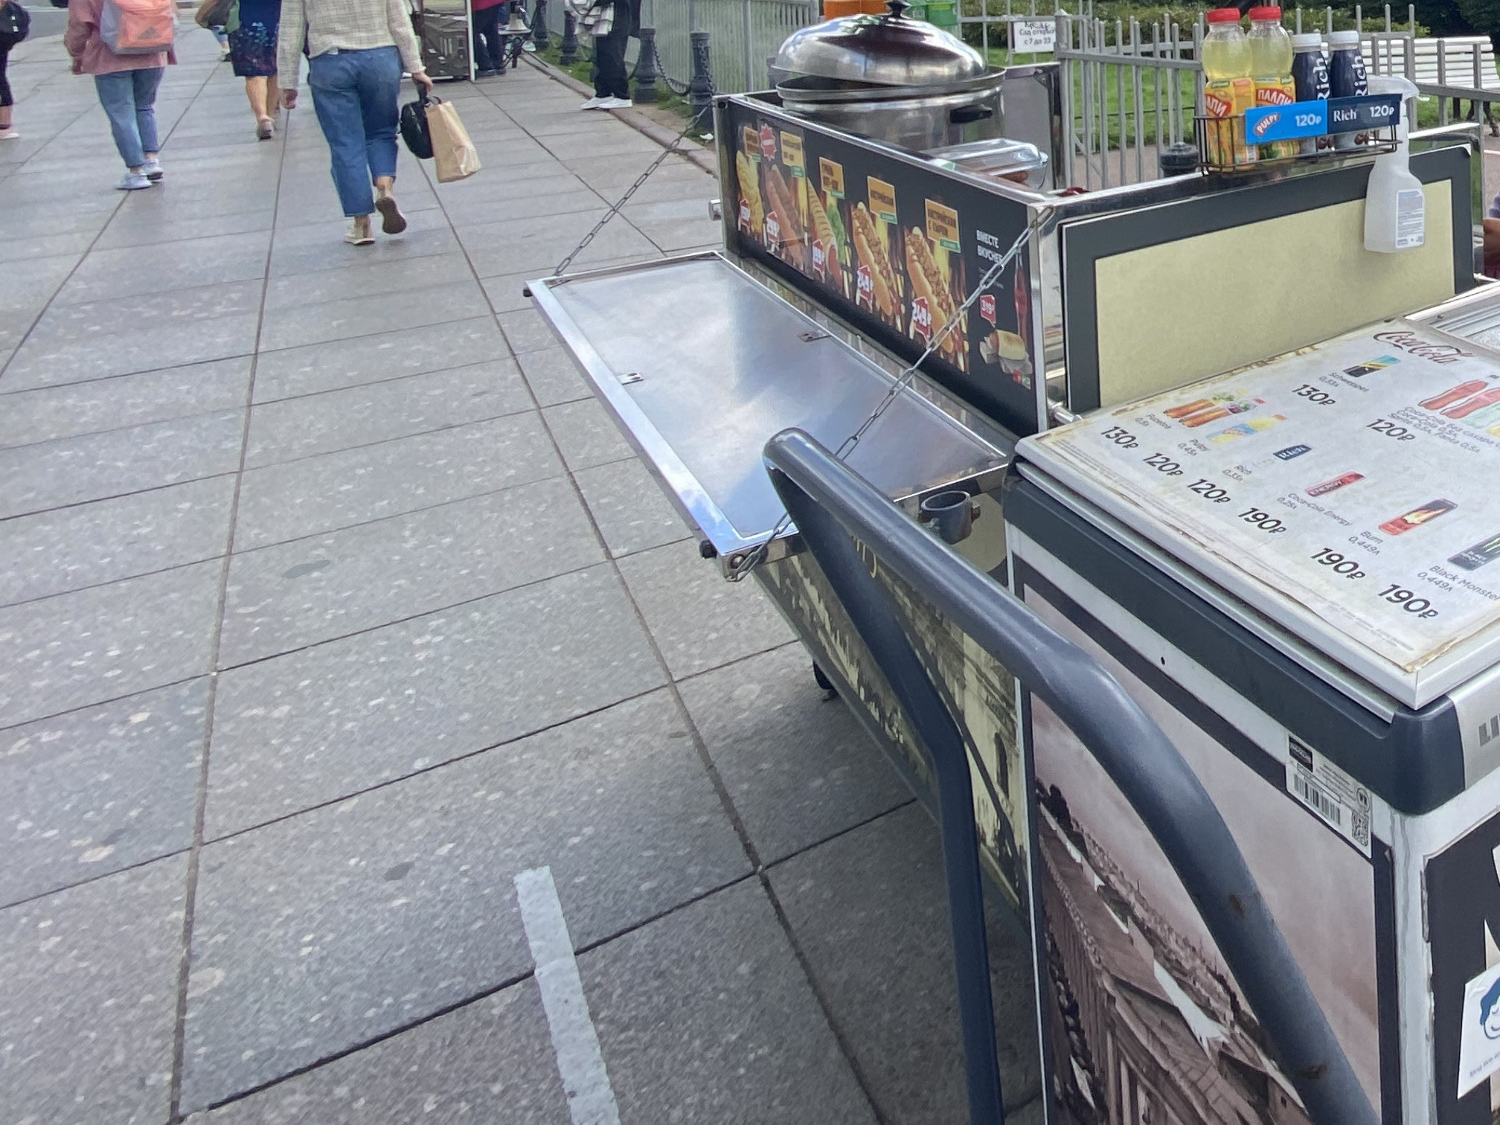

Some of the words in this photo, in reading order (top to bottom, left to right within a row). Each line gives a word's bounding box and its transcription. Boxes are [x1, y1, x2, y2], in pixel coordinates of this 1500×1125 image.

[1313, 56, 1330, 100] Rich
[1256, 114, 1279, 134] PULPY
[1333, 109, 1358, 123] Rich
[976, 229, 999, 249] ВМЕСТЕ
[1373, 330, 1473, 364] Coca-Cola
[1324, 510, 1353, 526] Energy
[1360, 530, 1384, 544] Burn
[1429, 565, 1460, 583] Black
